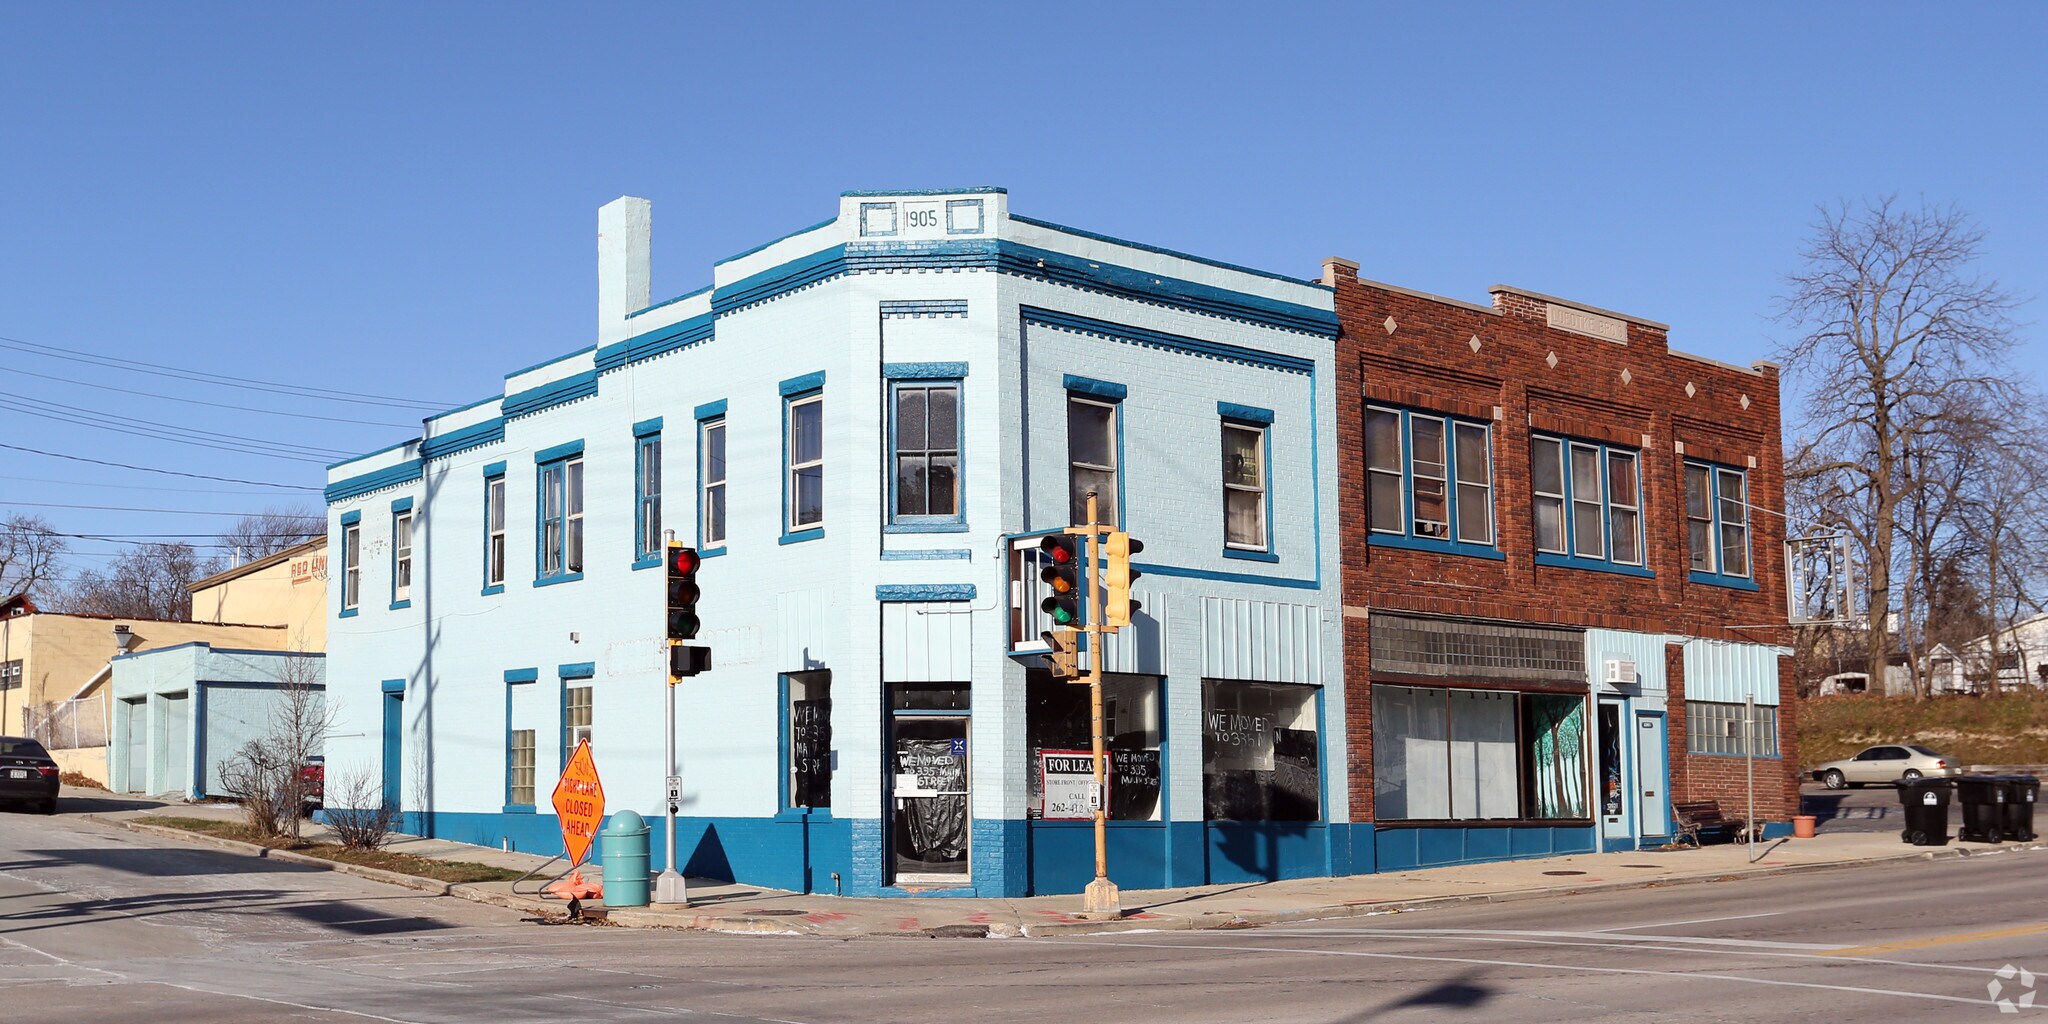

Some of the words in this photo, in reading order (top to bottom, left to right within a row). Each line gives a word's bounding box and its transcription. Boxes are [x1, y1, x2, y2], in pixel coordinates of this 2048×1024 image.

[905, 210, 938, 227] 1905
[1208, 711, 1227, 732] WE
[1230, 714, 1269, 733] MOVED
[1215, 731, 1229, 742] TO
[1048, 759, 1070, 772] FOR
[1072, 759, 1105, 772] LEA
[1068, 792, 1086, 800] CALL
[565, 798, 593, 818] CLOSED
[566, 819, 590, 838] AHEAD
